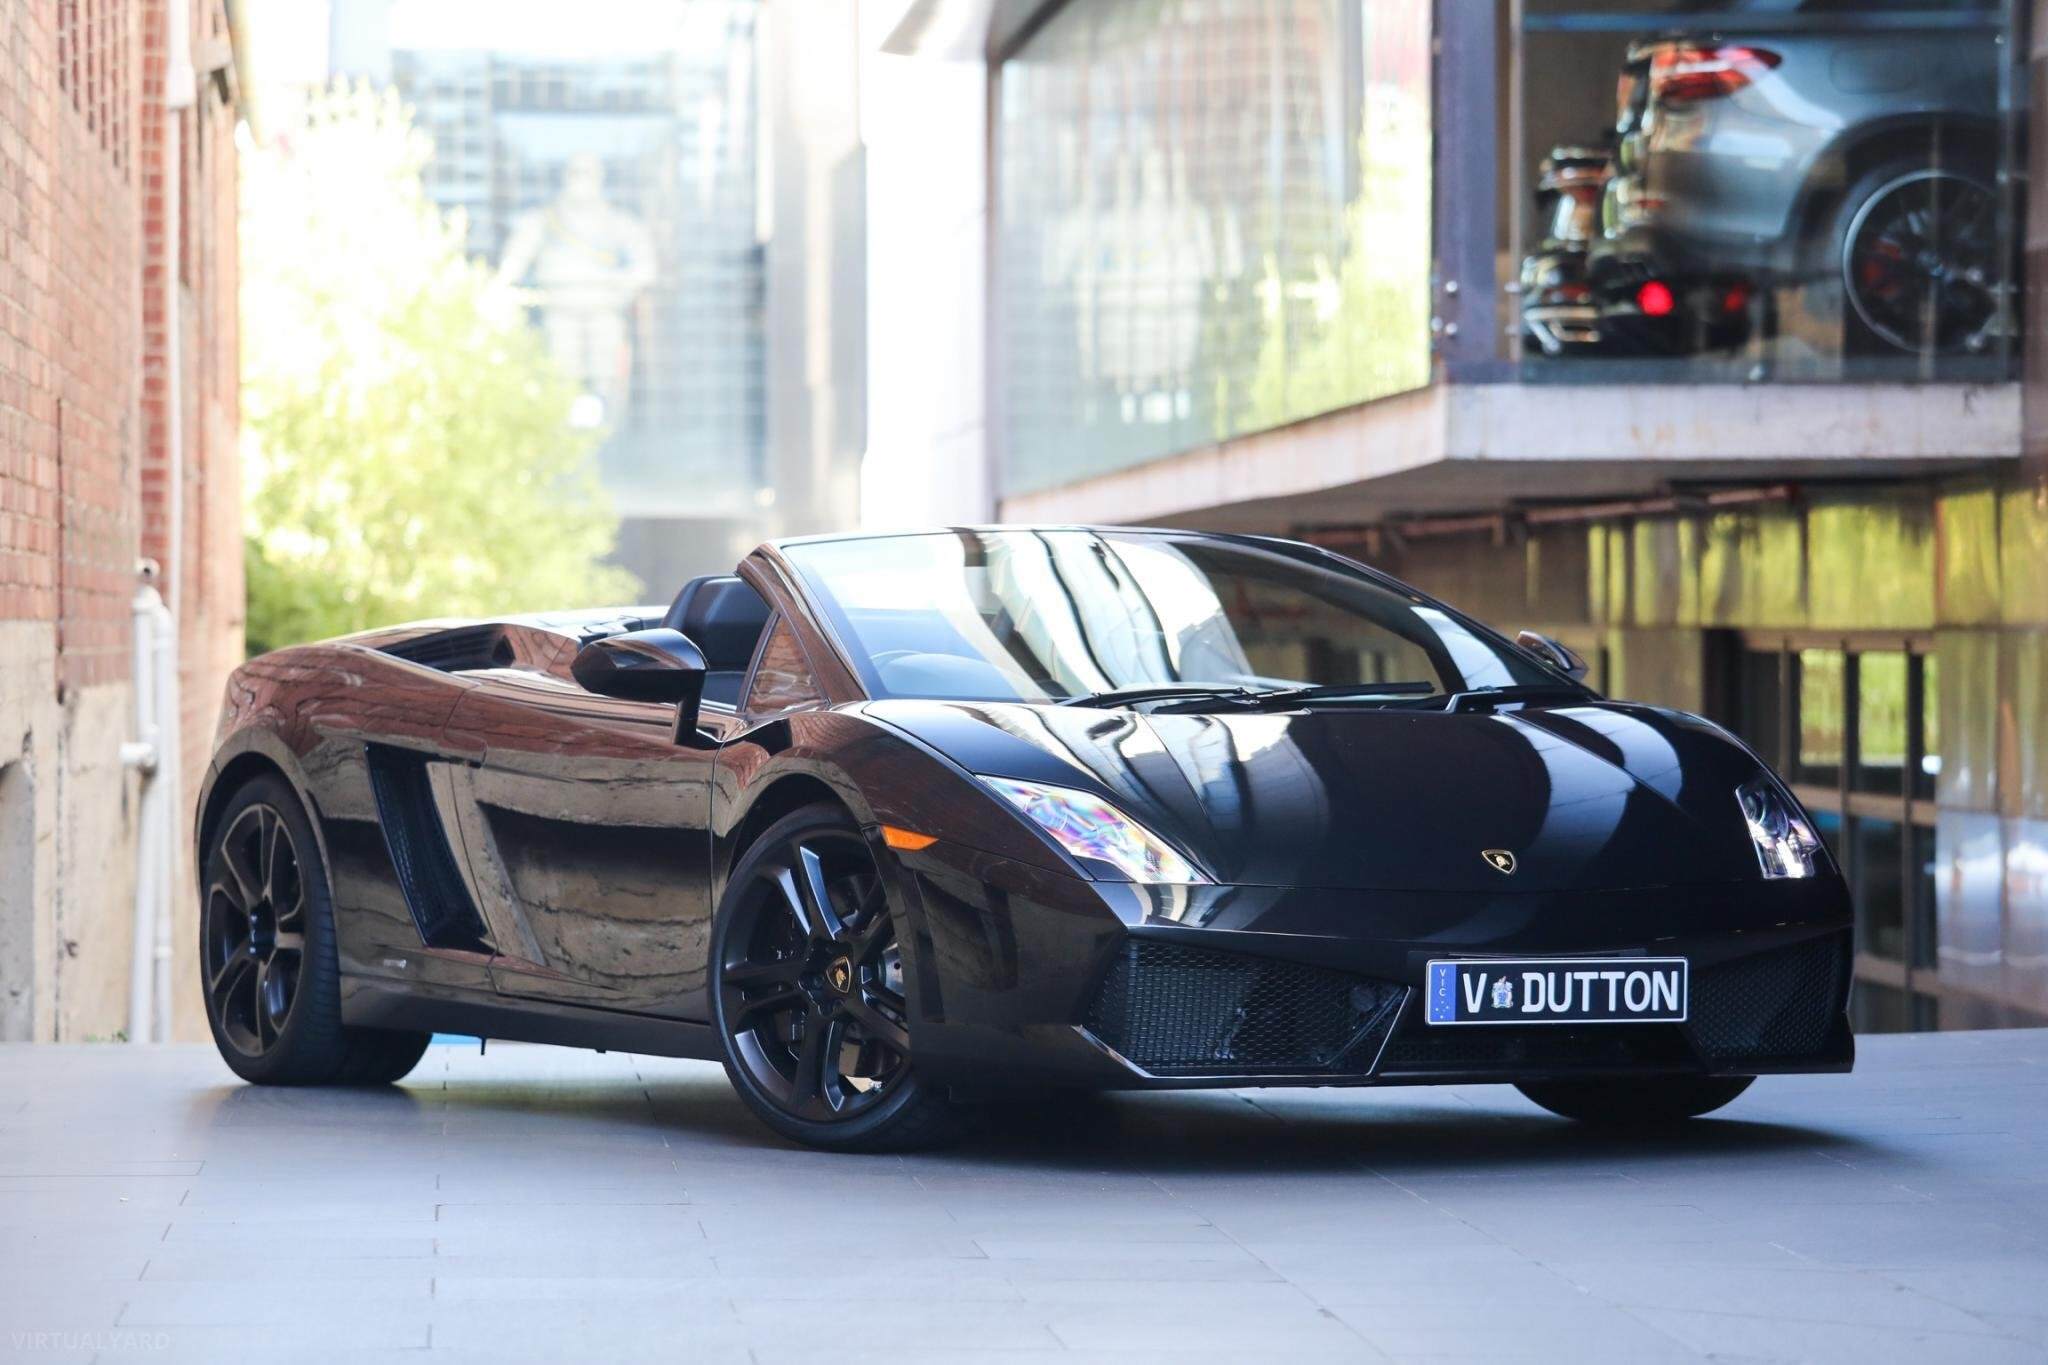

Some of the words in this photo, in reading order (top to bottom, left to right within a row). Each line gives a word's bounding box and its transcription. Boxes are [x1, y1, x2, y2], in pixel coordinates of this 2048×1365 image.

[1438, 968, 1446, 997] VIC
[1463, 973, 1488, 1013] V
[1521, 971, 1679, 1013] DUTTON
